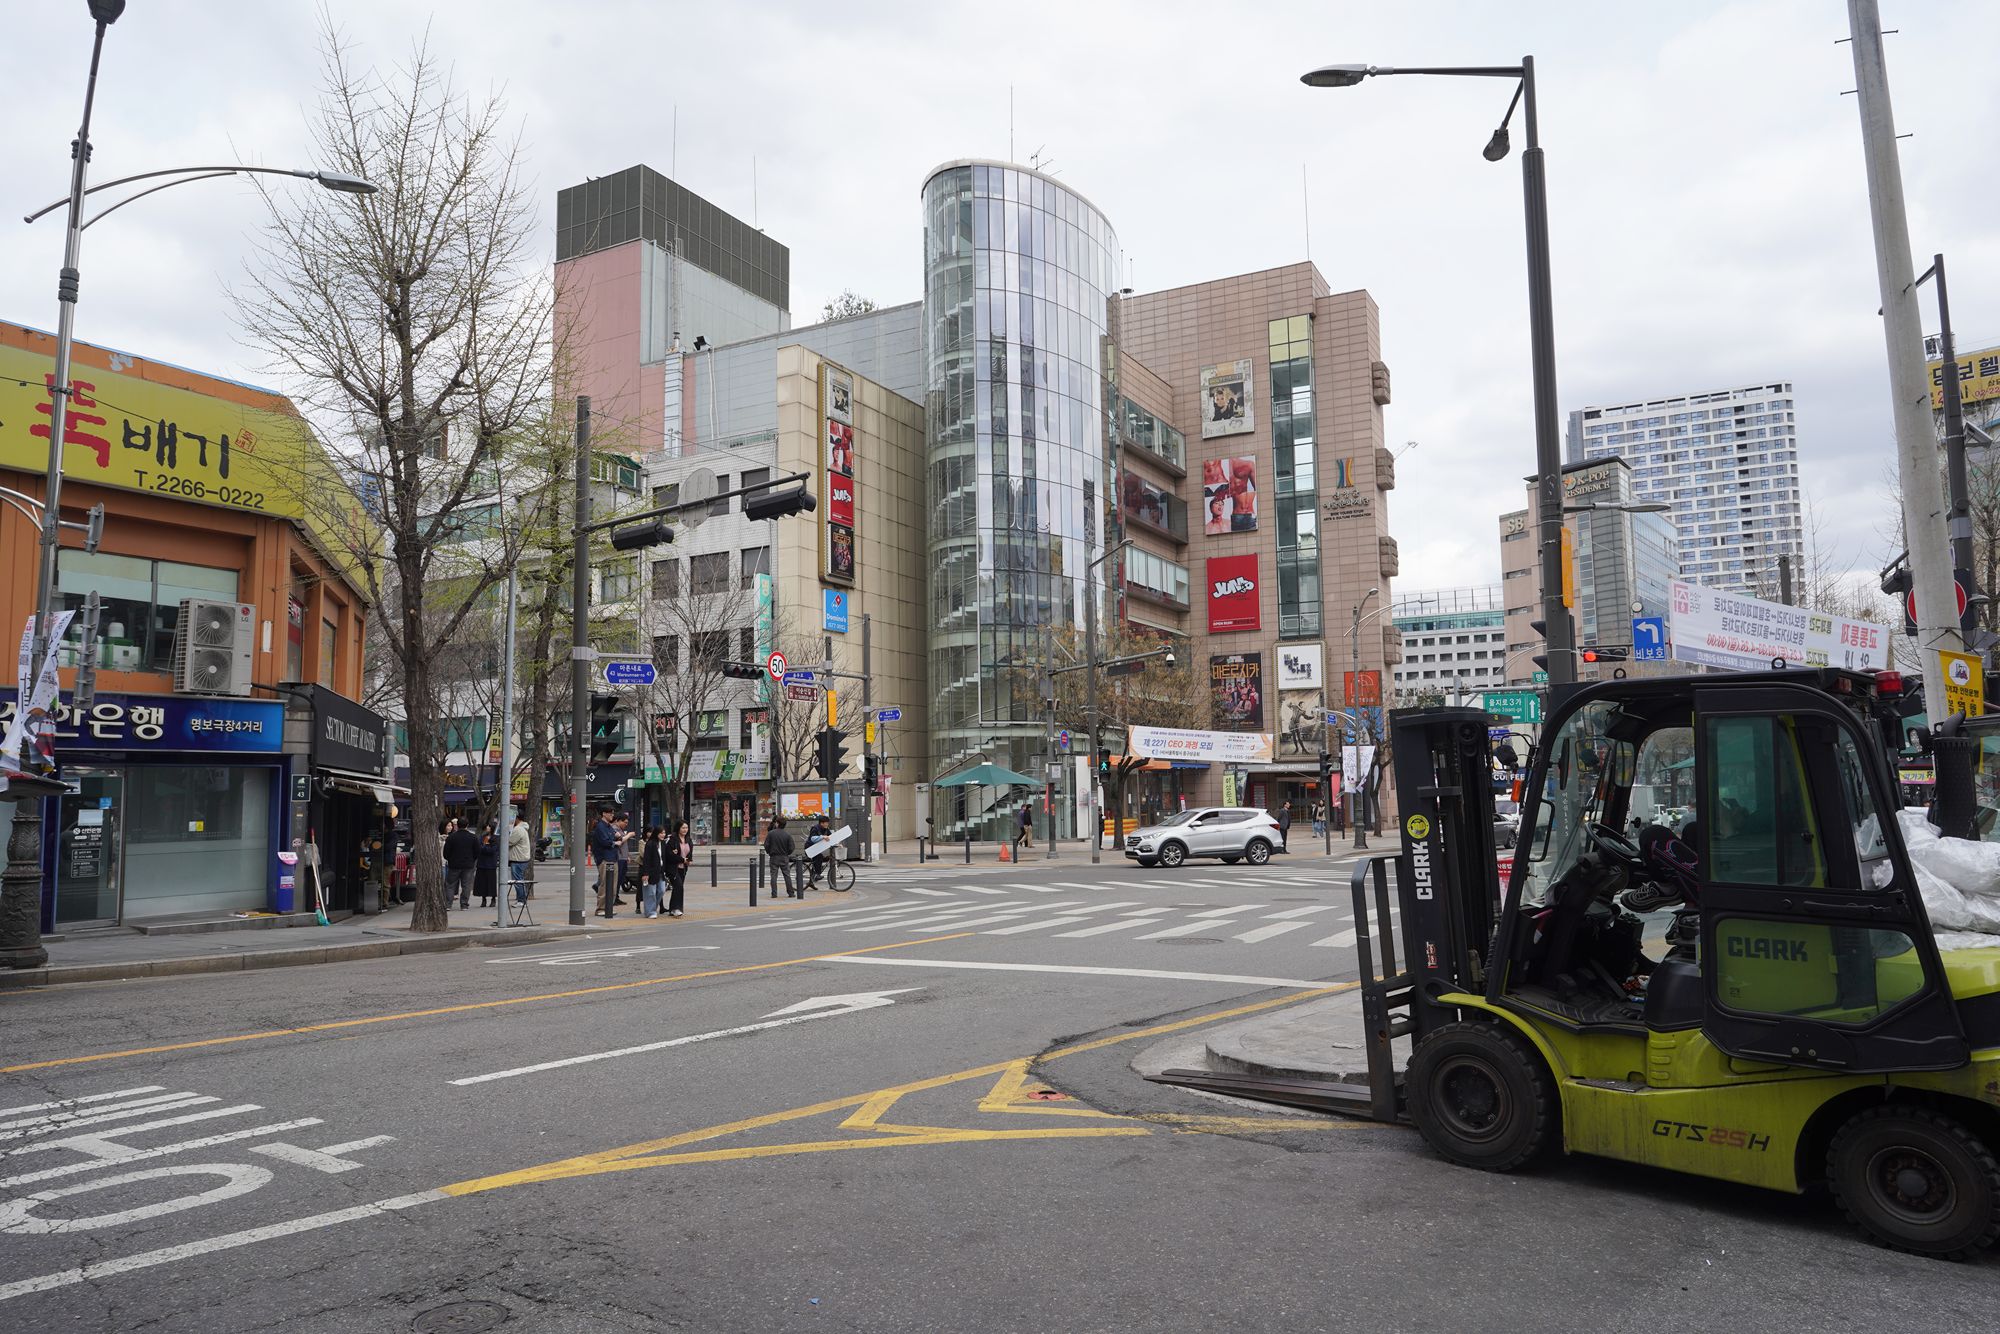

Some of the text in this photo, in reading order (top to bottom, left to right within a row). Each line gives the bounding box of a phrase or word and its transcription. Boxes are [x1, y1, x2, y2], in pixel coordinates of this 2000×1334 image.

[29, 373, 230, 480] 뚝배기
[1577, 470, 1610, 485] K-POP
[134, 469, 265, 509] T.2266-0222
[1564, 482, 1610, 498] RESIDENCE
[1507, 517, 1525, 534] SB
[826, 613, 847, 622] Domino's
[1635, 647, 1665, 660] 비보호
[619, 664, 643, 672] 마른내로
[772, 659, 784, 674] 50
[1535, 672, 1549, 682] 명보
[1488, 697, 1523, 707] 을지로3가
[0, 702, 263, 740] 한은행 명보극장4거리
[745, 711, 769, 724] 치과
[326, 715, 345, 743] SECTOR
[1143, 738, 1214, 750] 제 22기 CEO 과정 모집
[1411, 841, 1433, 900] CLARK
[1727, 936, 1809, 963] CLARK
